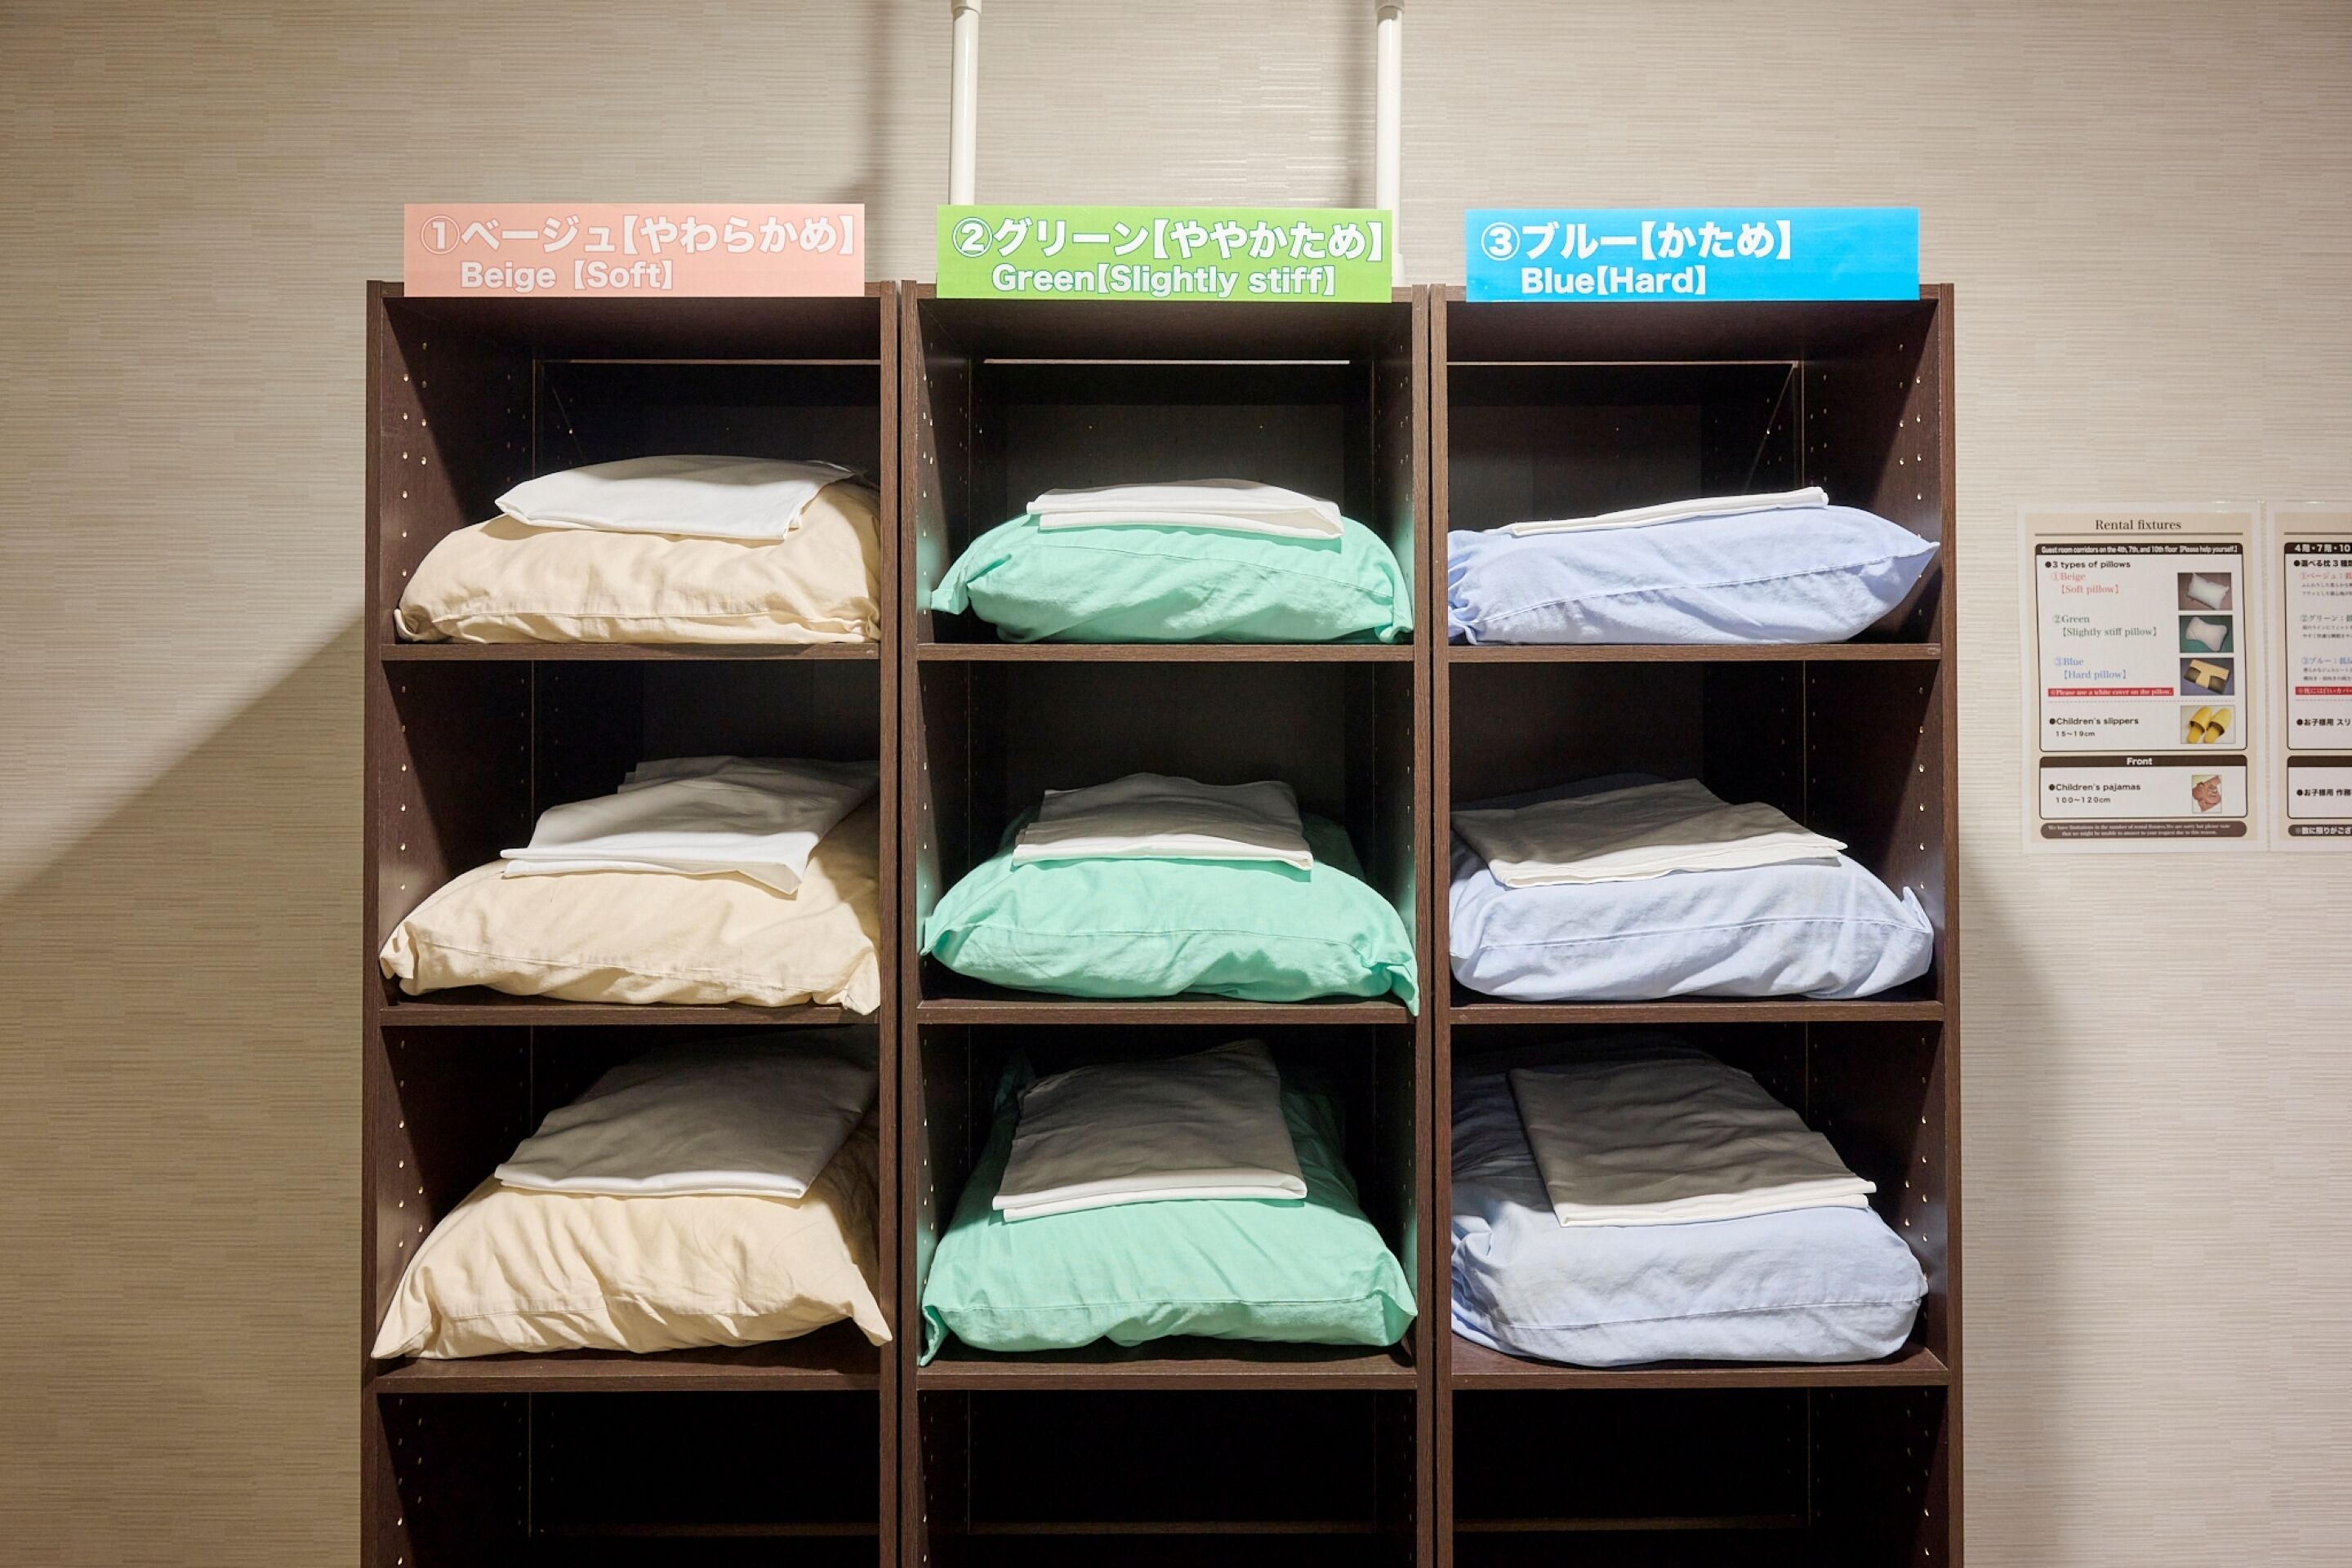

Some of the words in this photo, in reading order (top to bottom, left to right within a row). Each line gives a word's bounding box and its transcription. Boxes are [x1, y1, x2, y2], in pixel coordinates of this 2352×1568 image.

[461, 260, 556, 293] Beige
[2095, 519, 2133, 530] Rental
[2137, 519, 2181, 530] fixtures
[2058, 546, 2074, 554] room
[2074, 546, 2099, 554] corridors
[2099, 546, 2106, 554] on
[2107, 546, 2116, 554] the
[2140, 546, 2150, 554] and
[2164, 545, 2178, 554] floor
[2061, 561, 2086, 569] types
[2088, 560, 2098, 568] of
[2100, 560, 2131, 569] pillows
[2104, 627, 2123, 636] stiff
[2056, 717, 2101, 725] Children's
[2103, 717, 2139, 726] slippers
[2126, 757, 2153, 765] Front
[2056, 783, 2100, 791] Children's
[2103, 783, 2141, 792] pajamas
